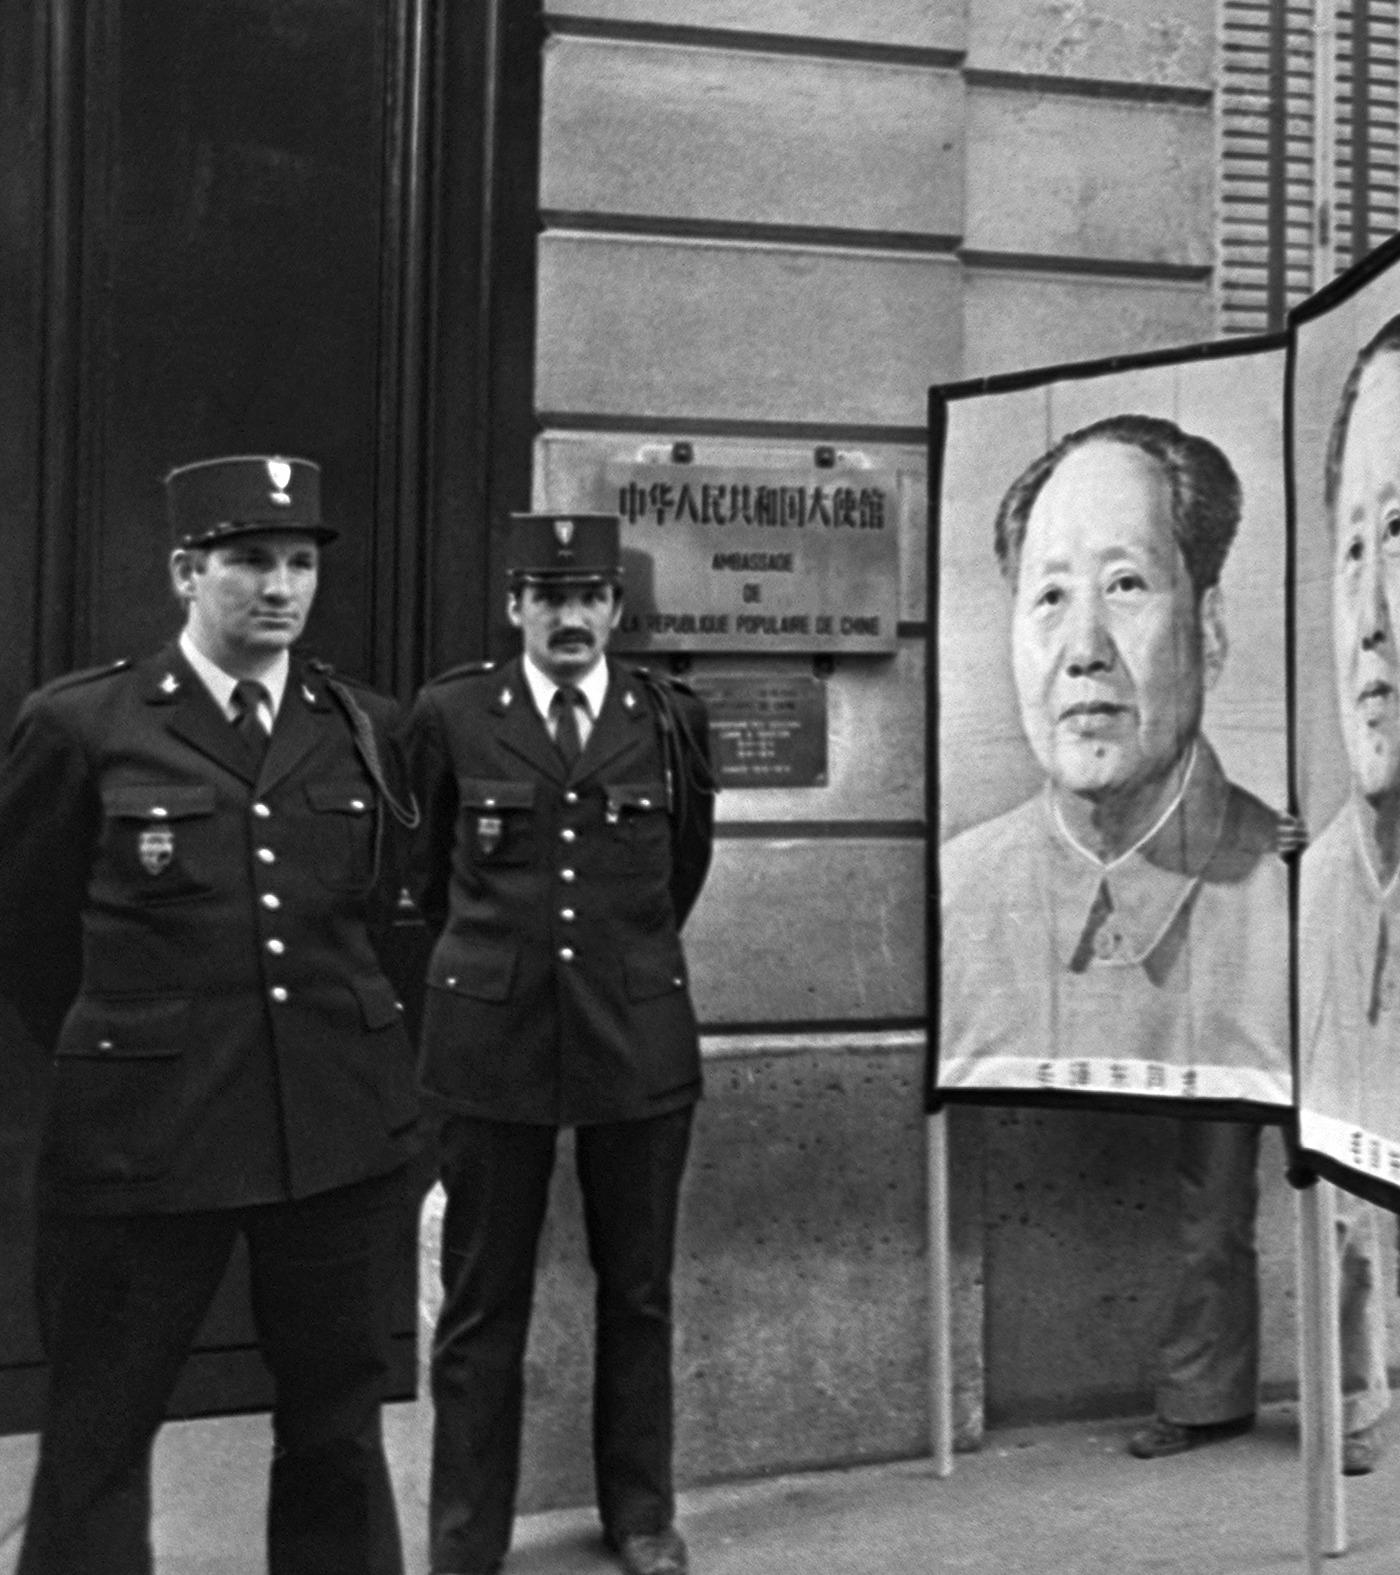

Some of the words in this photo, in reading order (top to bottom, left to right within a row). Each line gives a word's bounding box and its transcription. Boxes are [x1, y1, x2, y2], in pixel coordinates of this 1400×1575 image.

[618, 481, 887, 530] 中华人民共和国大使馆
[711, 552, 794, 573] AMBASSADE
[742, 583, 762, 604] DE
[620, 613, 641, 634] LA
[735, 614, 811, 637] POPULAIRE
[815, 615, 834, 637] DE
[839, 615, 881, 638] CHINE
